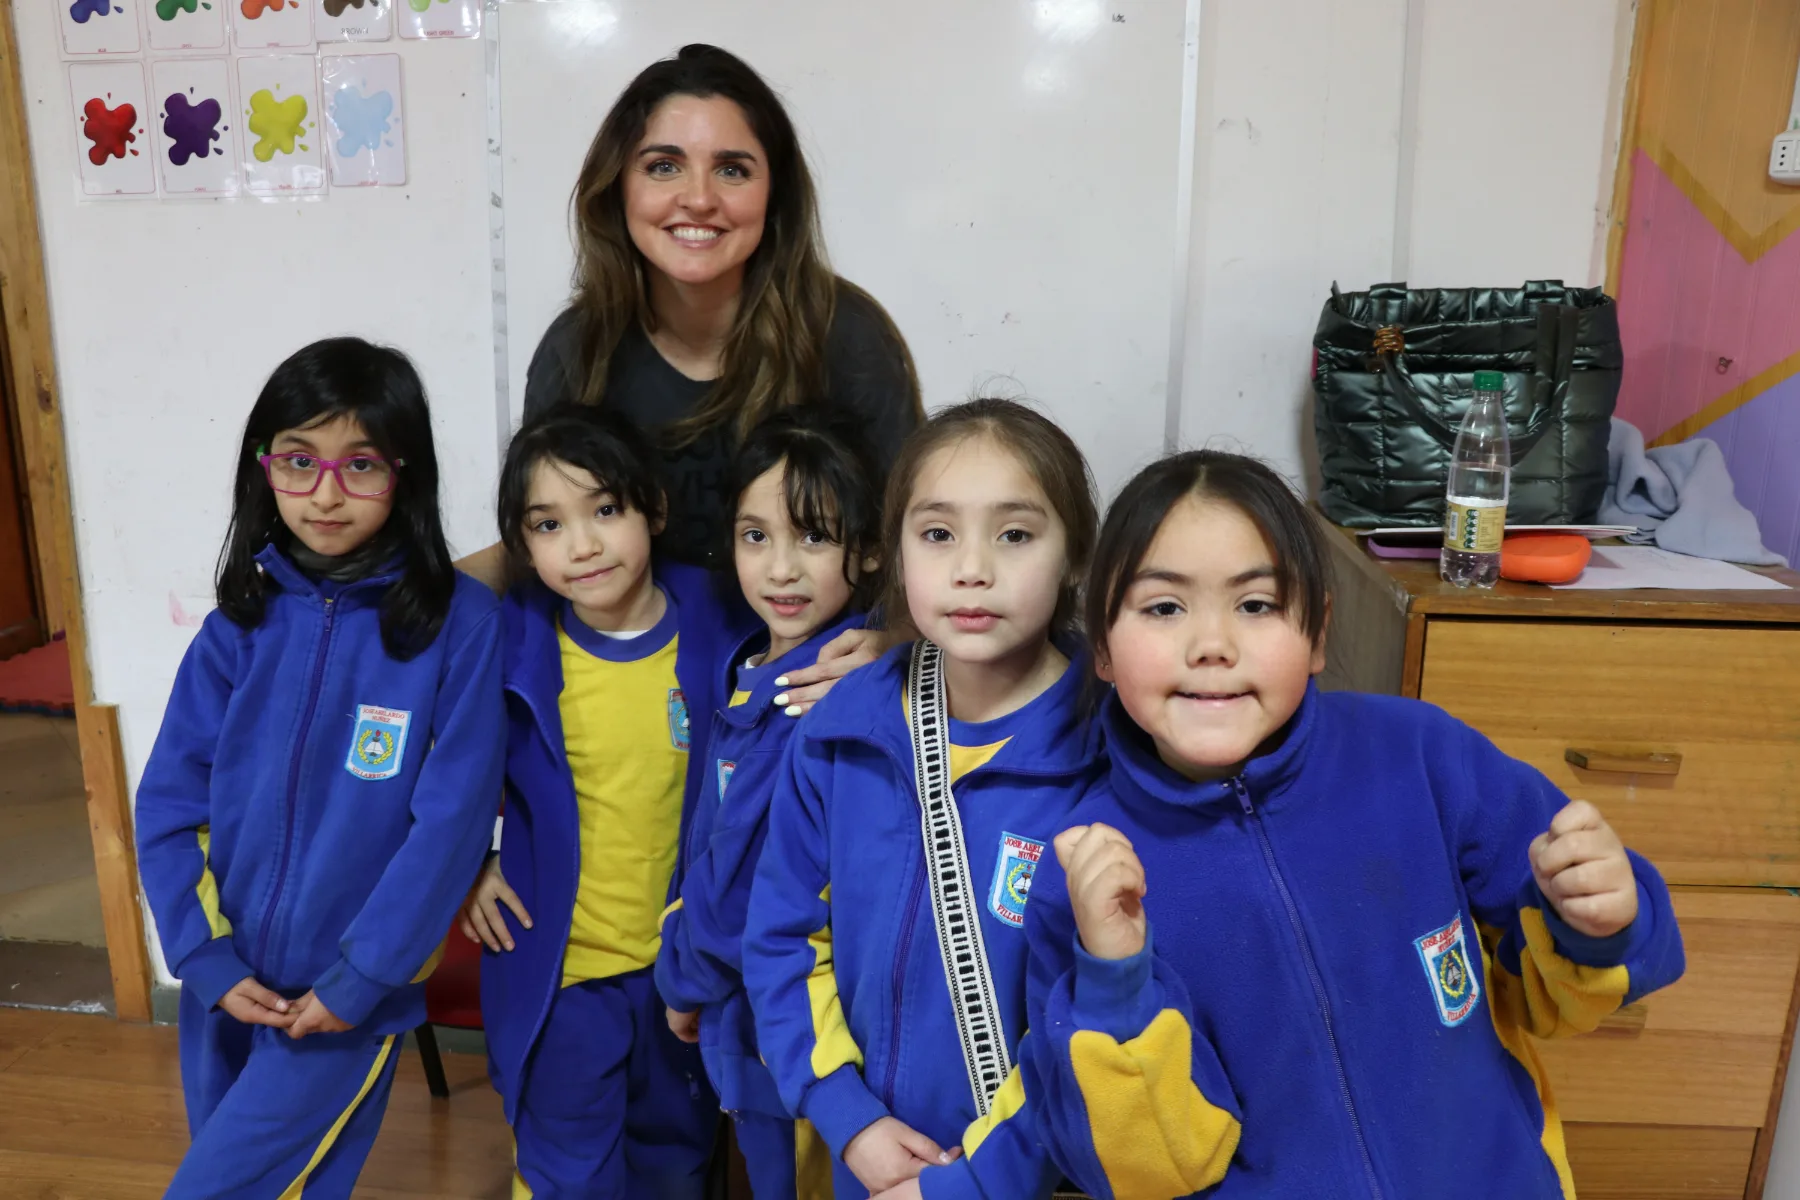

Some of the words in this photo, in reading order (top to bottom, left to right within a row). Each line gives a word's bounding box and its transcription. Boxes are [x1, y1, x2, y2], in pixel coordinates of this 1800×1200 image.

[1004, 837, 1022, 848] JOSE
[1023, 841, 1042, 854] ABEL
[1017, 850, 1040, 862] NUÑE
[997, 903, 1023, 924] VILLAR
